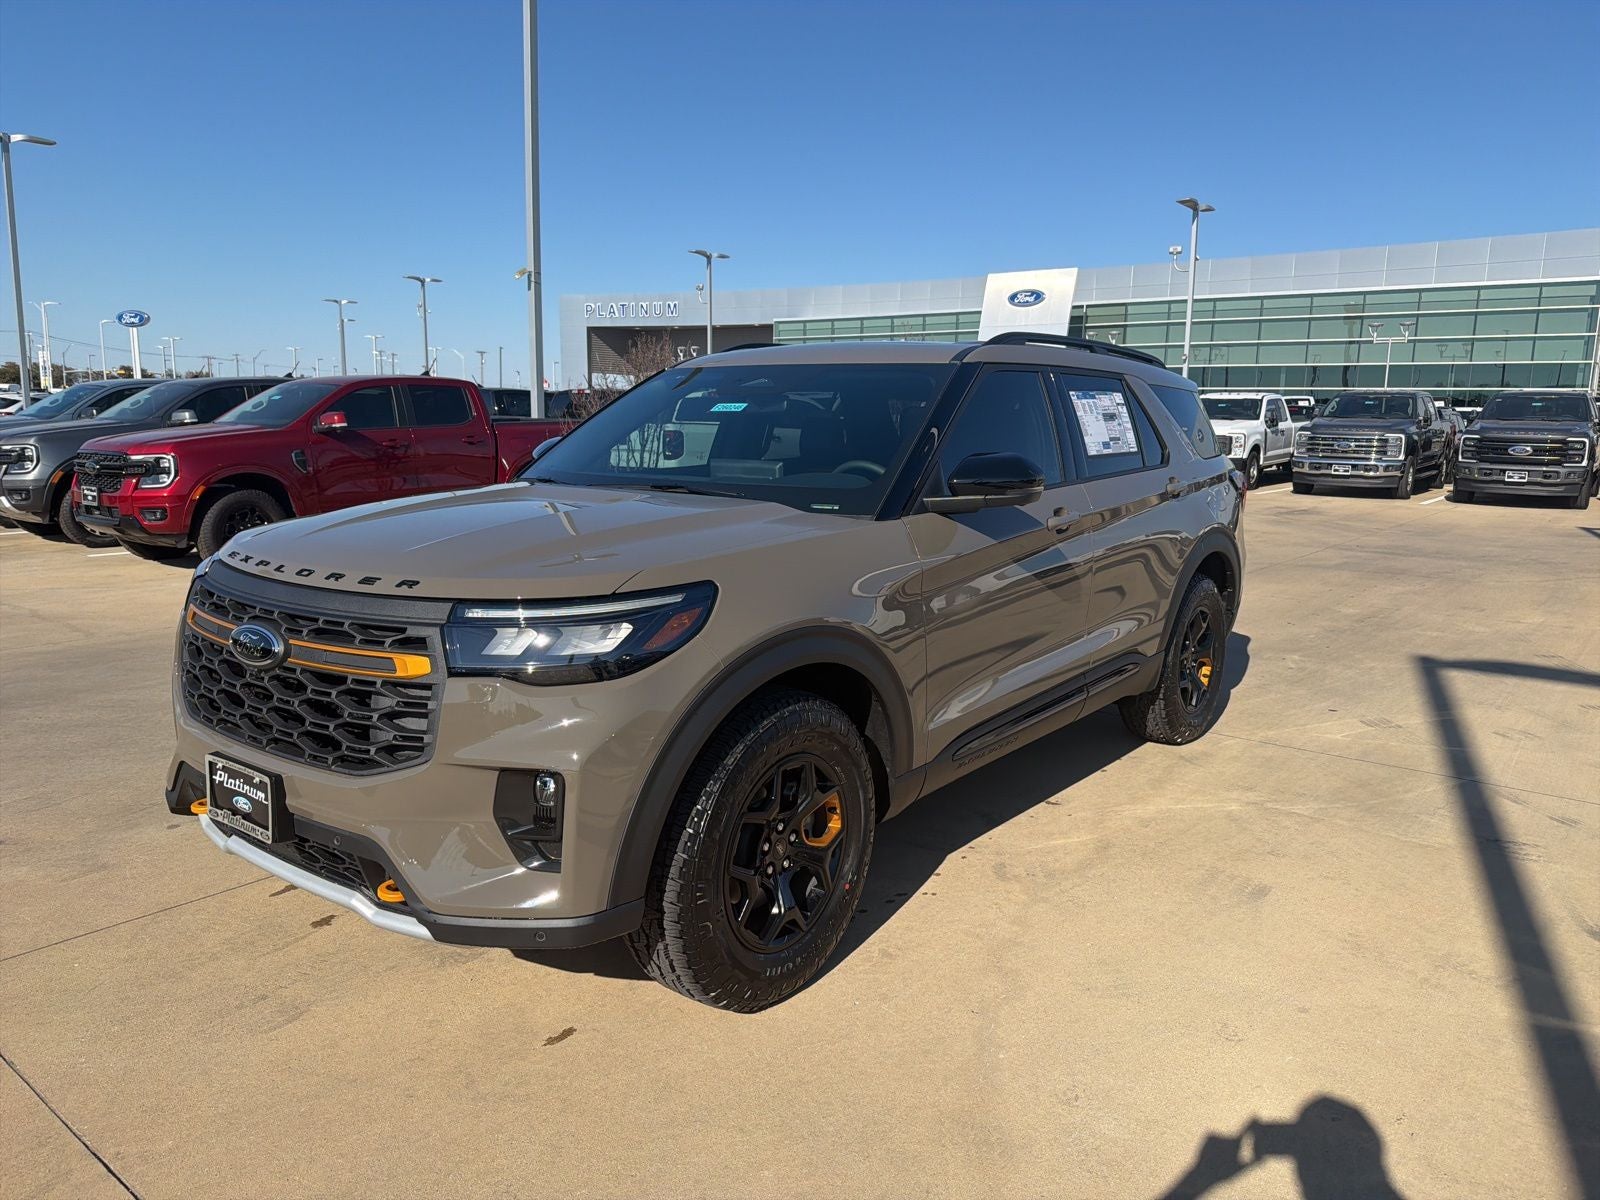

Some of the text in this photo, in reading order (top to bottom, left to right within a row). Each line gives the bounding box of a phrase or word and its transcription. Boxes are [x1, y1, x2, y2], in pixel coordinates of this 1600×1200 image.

[1014, 292, 1037, 303] Ford
[121, 312, 140, 324] Ford
[584, 301, 679, 318] PLATINUM
[227, 550, 421, 589] EXPLORER
[212, 770, 269, 805] Platinum
[221, 810, 260, 837] Platinum
